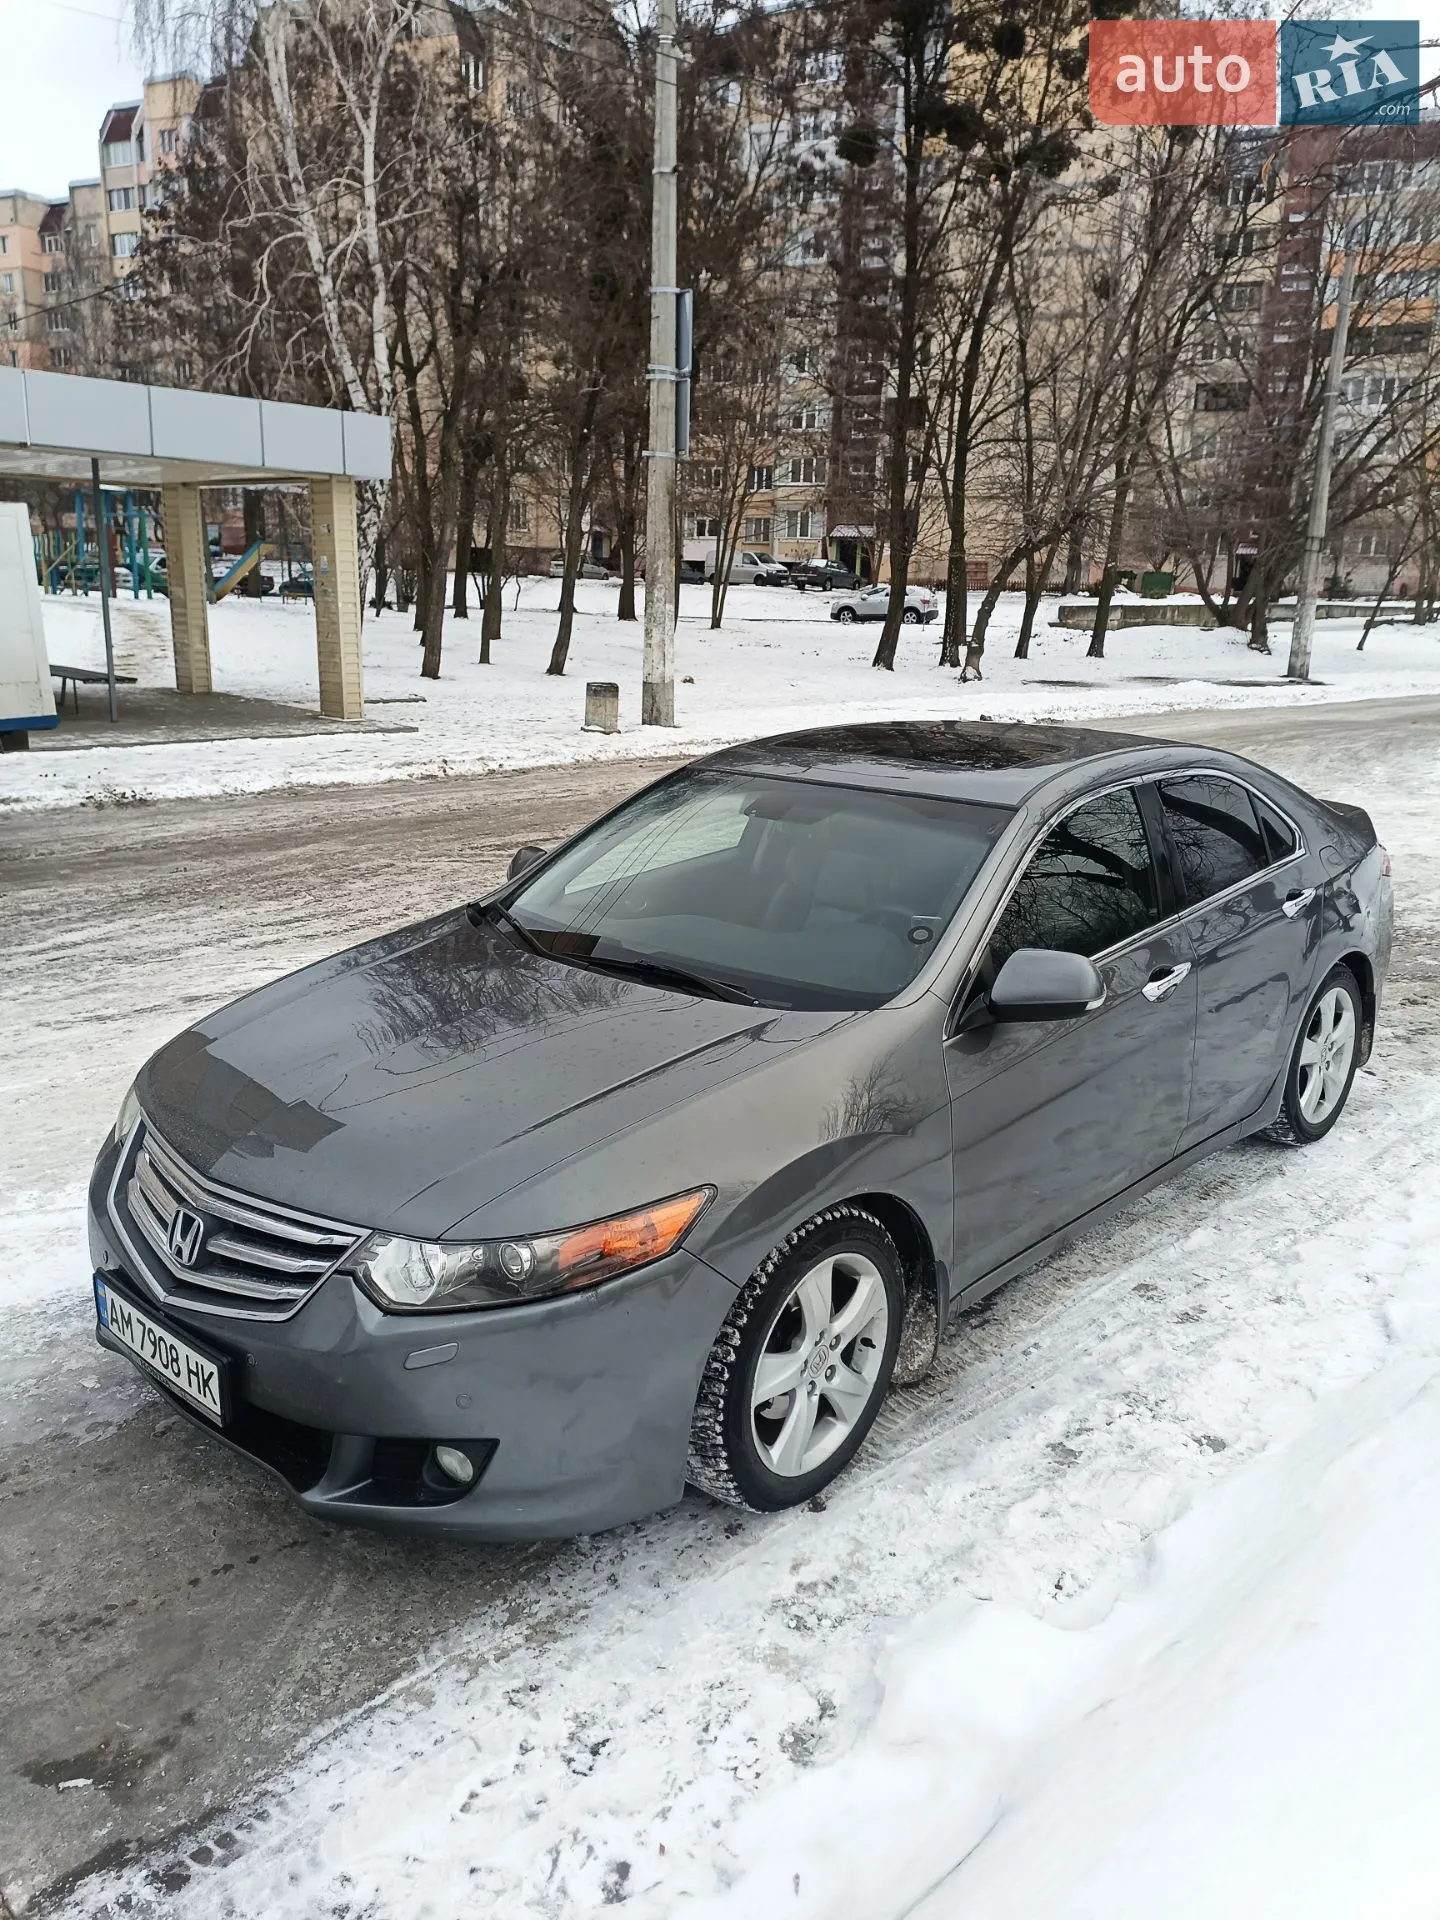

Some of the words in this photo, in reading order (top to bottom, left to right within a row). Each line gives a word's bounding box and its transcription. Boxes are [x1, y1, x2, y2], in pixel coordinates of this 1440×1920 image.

[110, 1298, 134, 1344] AM
[136, 1317, 181, 1378] 7908
[186, 1354, 218, 1406] HK
